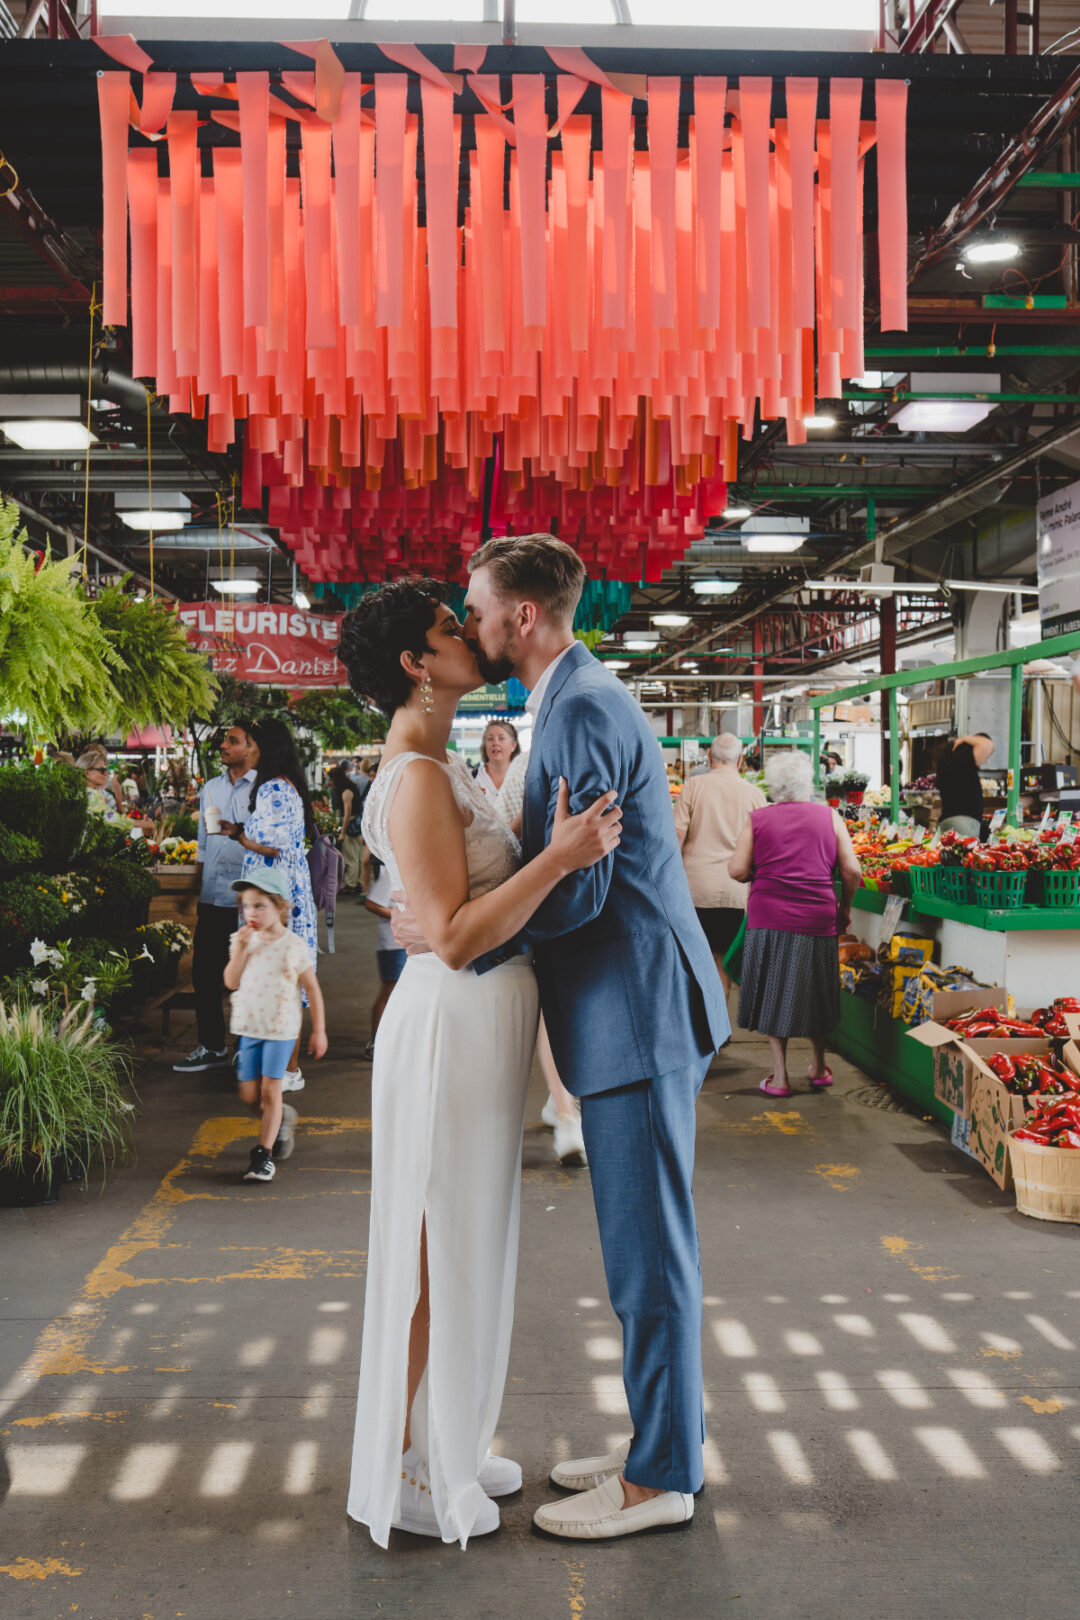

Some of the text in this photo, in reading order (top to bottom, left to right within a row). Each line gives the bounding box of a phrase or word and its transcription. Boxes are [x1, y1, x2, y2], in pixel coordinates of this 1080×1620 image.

[1055, 497, 1072, 514] André
[180, 609, 338, 640] FLEURISTE
[245, 642, 338, 676] Daniel
